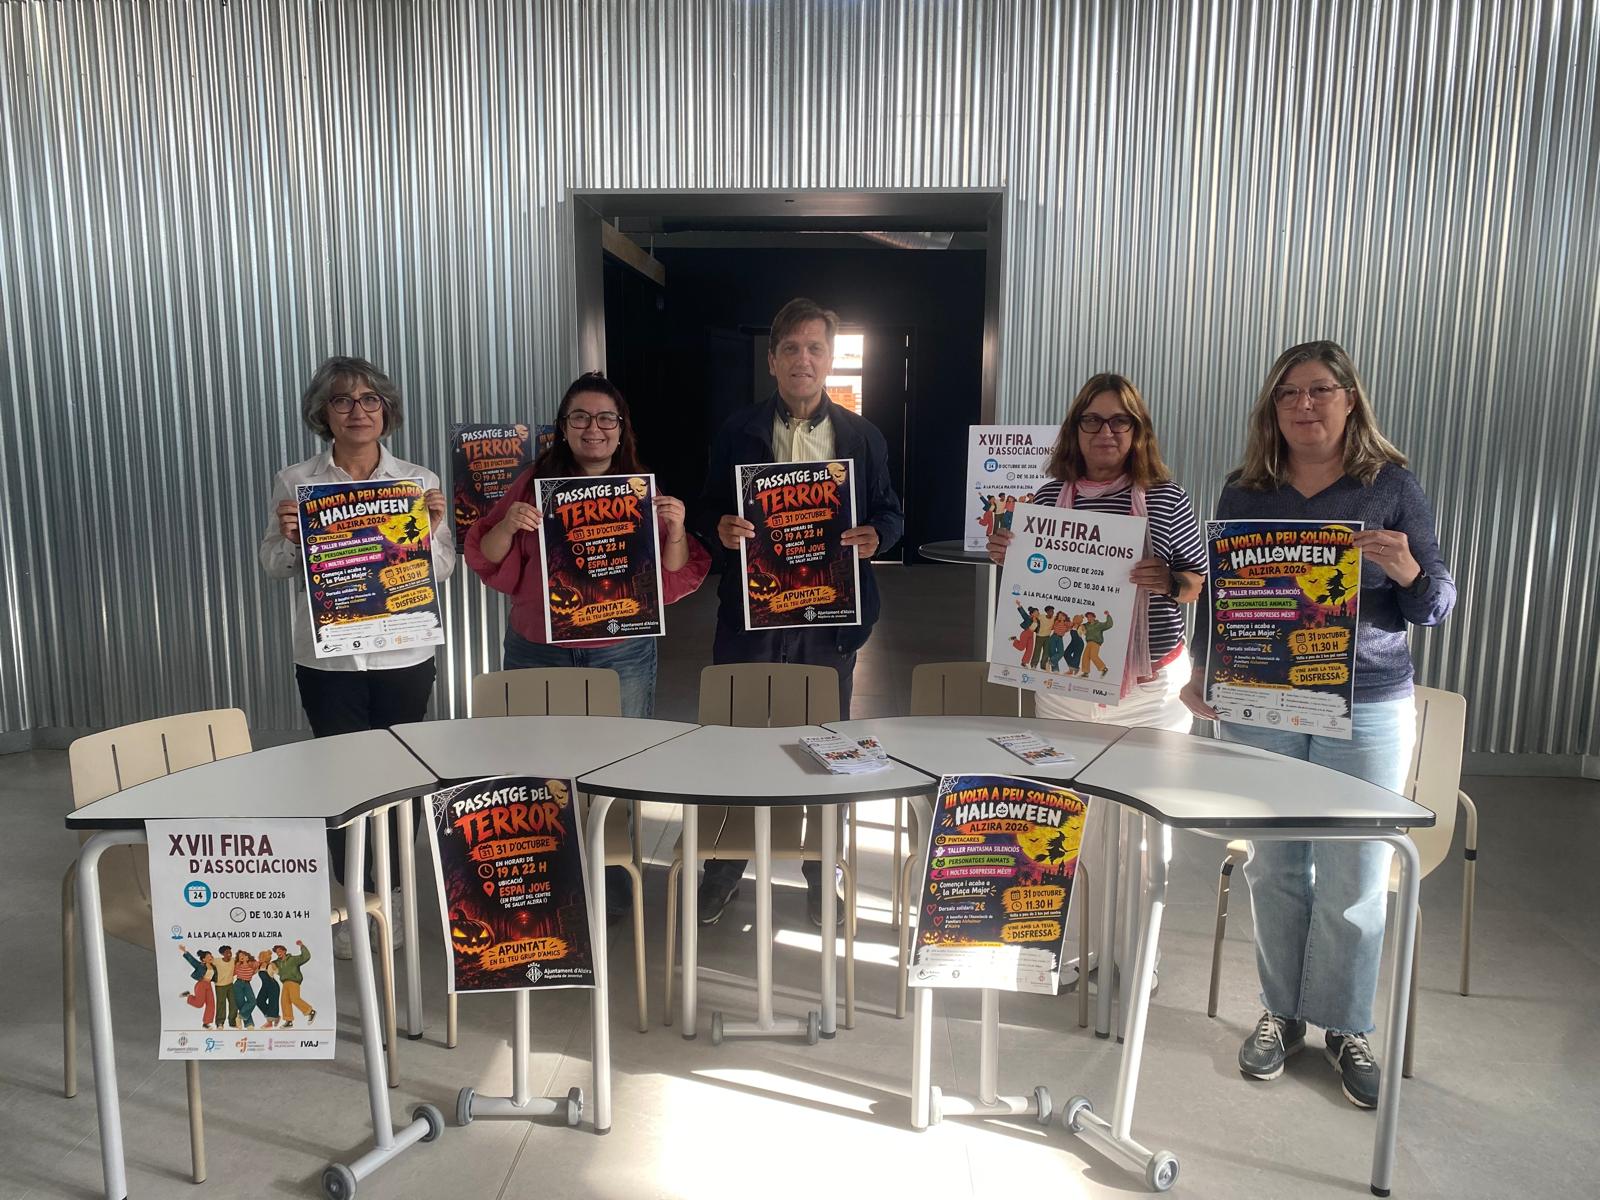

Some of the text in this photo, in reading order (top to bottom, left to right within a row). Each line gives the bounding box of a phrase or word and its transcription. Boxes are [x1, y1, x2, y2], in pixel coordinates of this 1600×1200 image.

[461, 428, 518, 443] PASSATGE DEL
[979, 433, 1033, 446] XVII FIRA
[461, 437, 525, 460] TERROR
[755, 468, 832, 492] PASSATGE DEL
[305, 489, 375, 514] III VOLTA A PEU
[555, 483, 633, 506] PASSATGE DEL
[755, 481, 841, 513] TERROR
[319, 498, 409, 526] HALLOWEEN
[555, 495, 643, 527] TERROR
[784, 510, 826, 523] 31 D'OCTUBRE
[336, 516, 386, 531] ALZIRA 2026
[1023, 515, 1101, 542] XVII FIRA
[586, 529, 595, 537] 31
[785, 527, 824, 541] 19 A 22 H
[586, 541, 626, 555] 19 A 22 H
[785, 542, 826, 556] ESPAI JOVE
[1034, 536, 1134, 559] D'ASSOCIACIONS
[1216, 539, 1230, 553] III
[1230, 533, 1263, 548] VOLTA
[1265, 531, 1273, 545] A
[1275, 531, 1297, 544] PEU
[588, 555, 629, 569] ESPAI JOVE
[1230, 545, 1337, 570] HALLOWEEN
[395, 567, 403, 575] 31
[1081, 567, 1089, 575] DE
[1248, 565, 1307, 577] ALZIRA 2026
[1073, 581, 1082, 589] DE
[1083, 583, 1100, 592] 10.30
[395, 593, 429, 608] DISFRESSA
[783, 588, 821, 602] APUNTA'T
[1053, 594, 1071, 603] MAJOR
[585, 601, 624, 615] APUNTA'T
[1238, 629, 1276, 638] Plaça Major
[1307, 632, 1316, 642] 31
[1311, 640, 1339, 652] 11.30 H
[1300, 672, 1341, 682] DISFRESSA
[1092, 688, 1108, 697] IVAJ
[452, 786, 552, 818] PASSATGE DEL
[944, 786, 1083, 813] III VOLTA A PEU SOLIDÀRIA
[955, 801, 1062, 827] HALLOWEEN
[454, 802, 567, 844] TERROR
[970, 822, 1029, 833] ALZIRA 2026
[168, 834, 274, 857] XVII FIRA
[482, 839, 550, 857] 31 31 D'OCTUBRE
[190, 859, 318, 874] D'ASSOCIACIONS
[504, 857, 525, 866] HORARI
[497, 861, 547, 878] 19 A 22 H
[498, 876, 523, 887] UBICACIÓ
[939, 881, 964, 889] Comença
[193, 890, 286, 900] 24 D'OCTUBRE DE 2026
[499, 881, 551, 897] ESPAI JOVE
[942, 887, 990, 896] la Plaça Major
[1023, 889, 1031, 899] 31
[974, 902, 985, 911] 2€
[1026, 899, 1053, 910] 11.30 H
[250, 910, 310, 919] DE 10.30 A 14 H
[187, 931, 192, 939] A
[193, 931, 203, 939] LA
[203, 931, 226, 941] PLAÇA
[227, 931, 250, 939] MAJOR
[1012, 929, 1053, 939] DISFRESSA
[498, 940, 547, 956] APUNTA'T
[537, 950, 561, 958] D'AMICS
[300, 1040, 319, 1048] IVAJ
